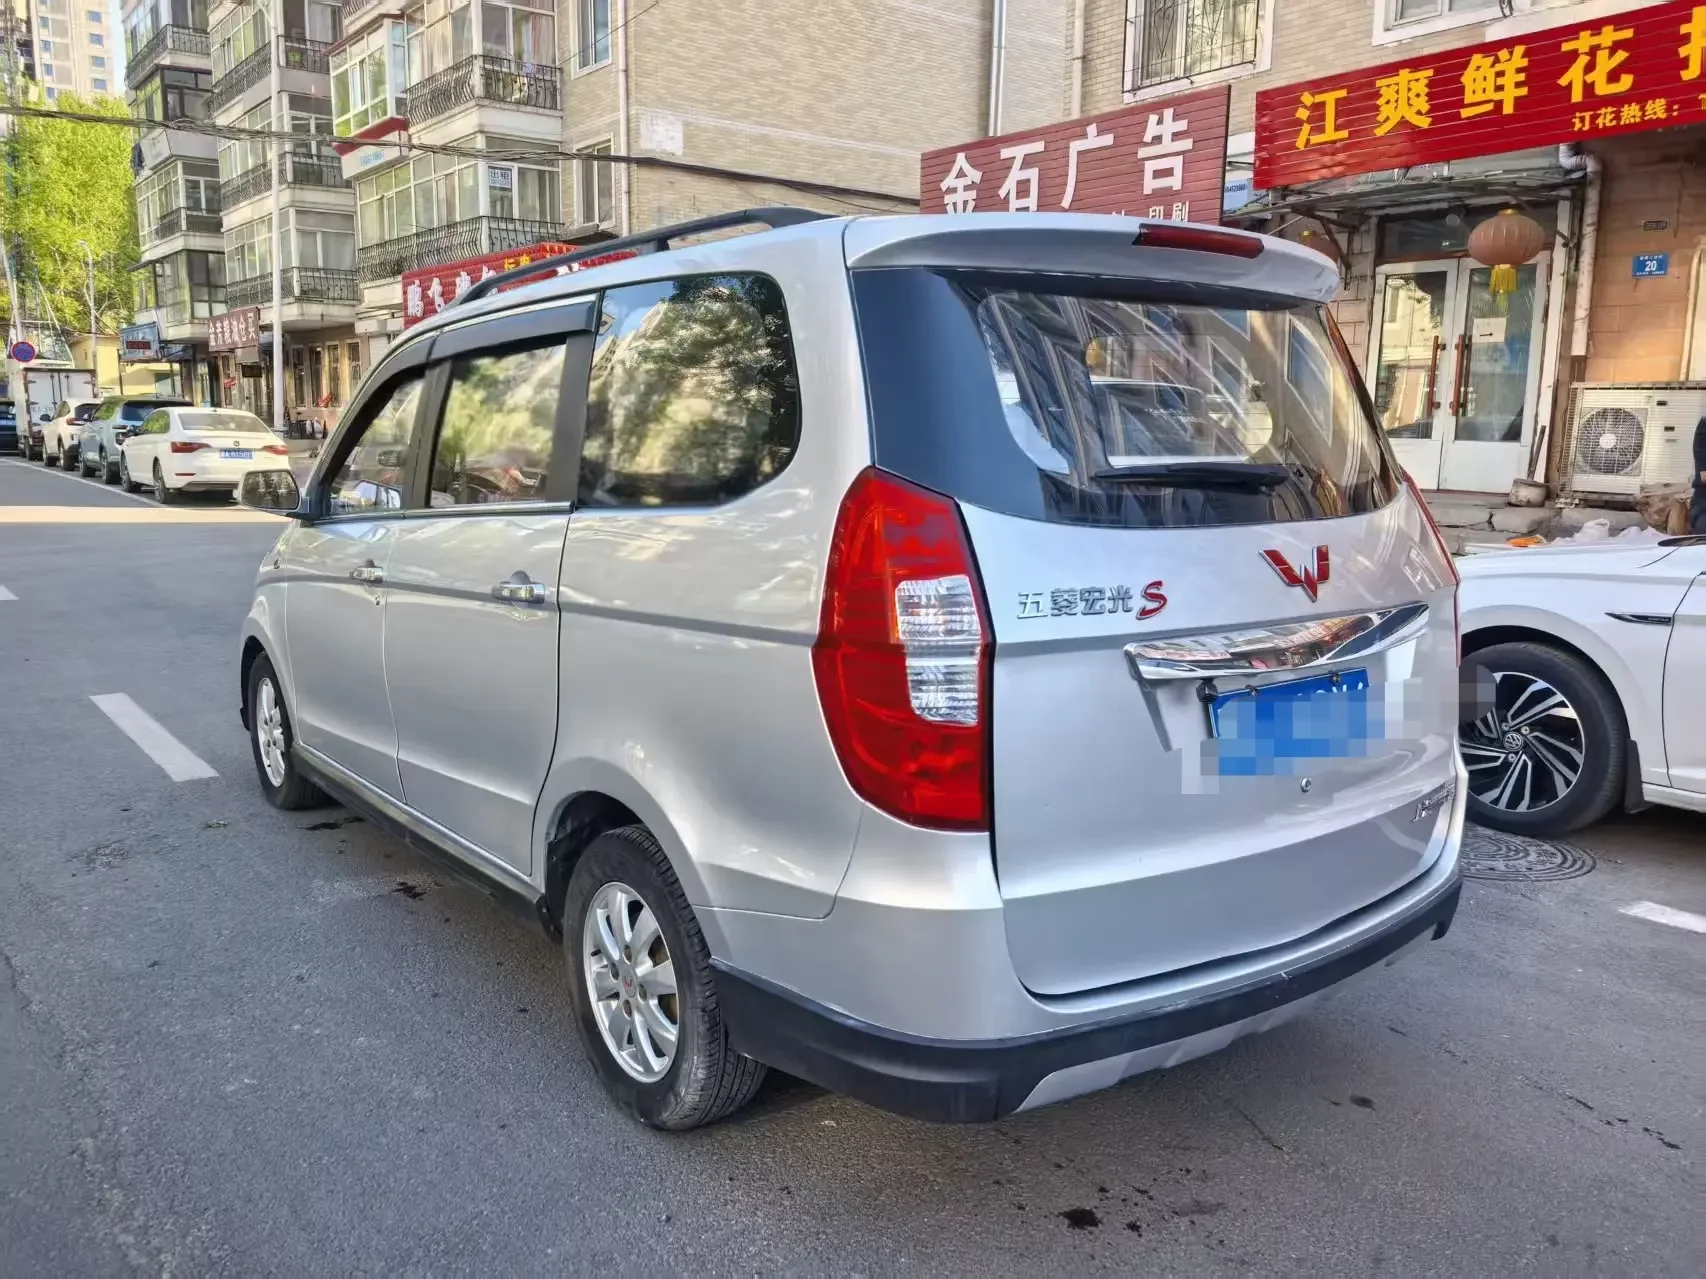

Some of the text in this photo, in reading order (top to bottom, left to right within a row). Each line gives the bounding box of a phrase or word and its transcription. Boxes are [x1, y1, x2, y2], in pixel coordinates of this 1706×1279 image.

[939, 107, 1194, 215] 金石广告
[1645, 260, 1658, 272] 20
